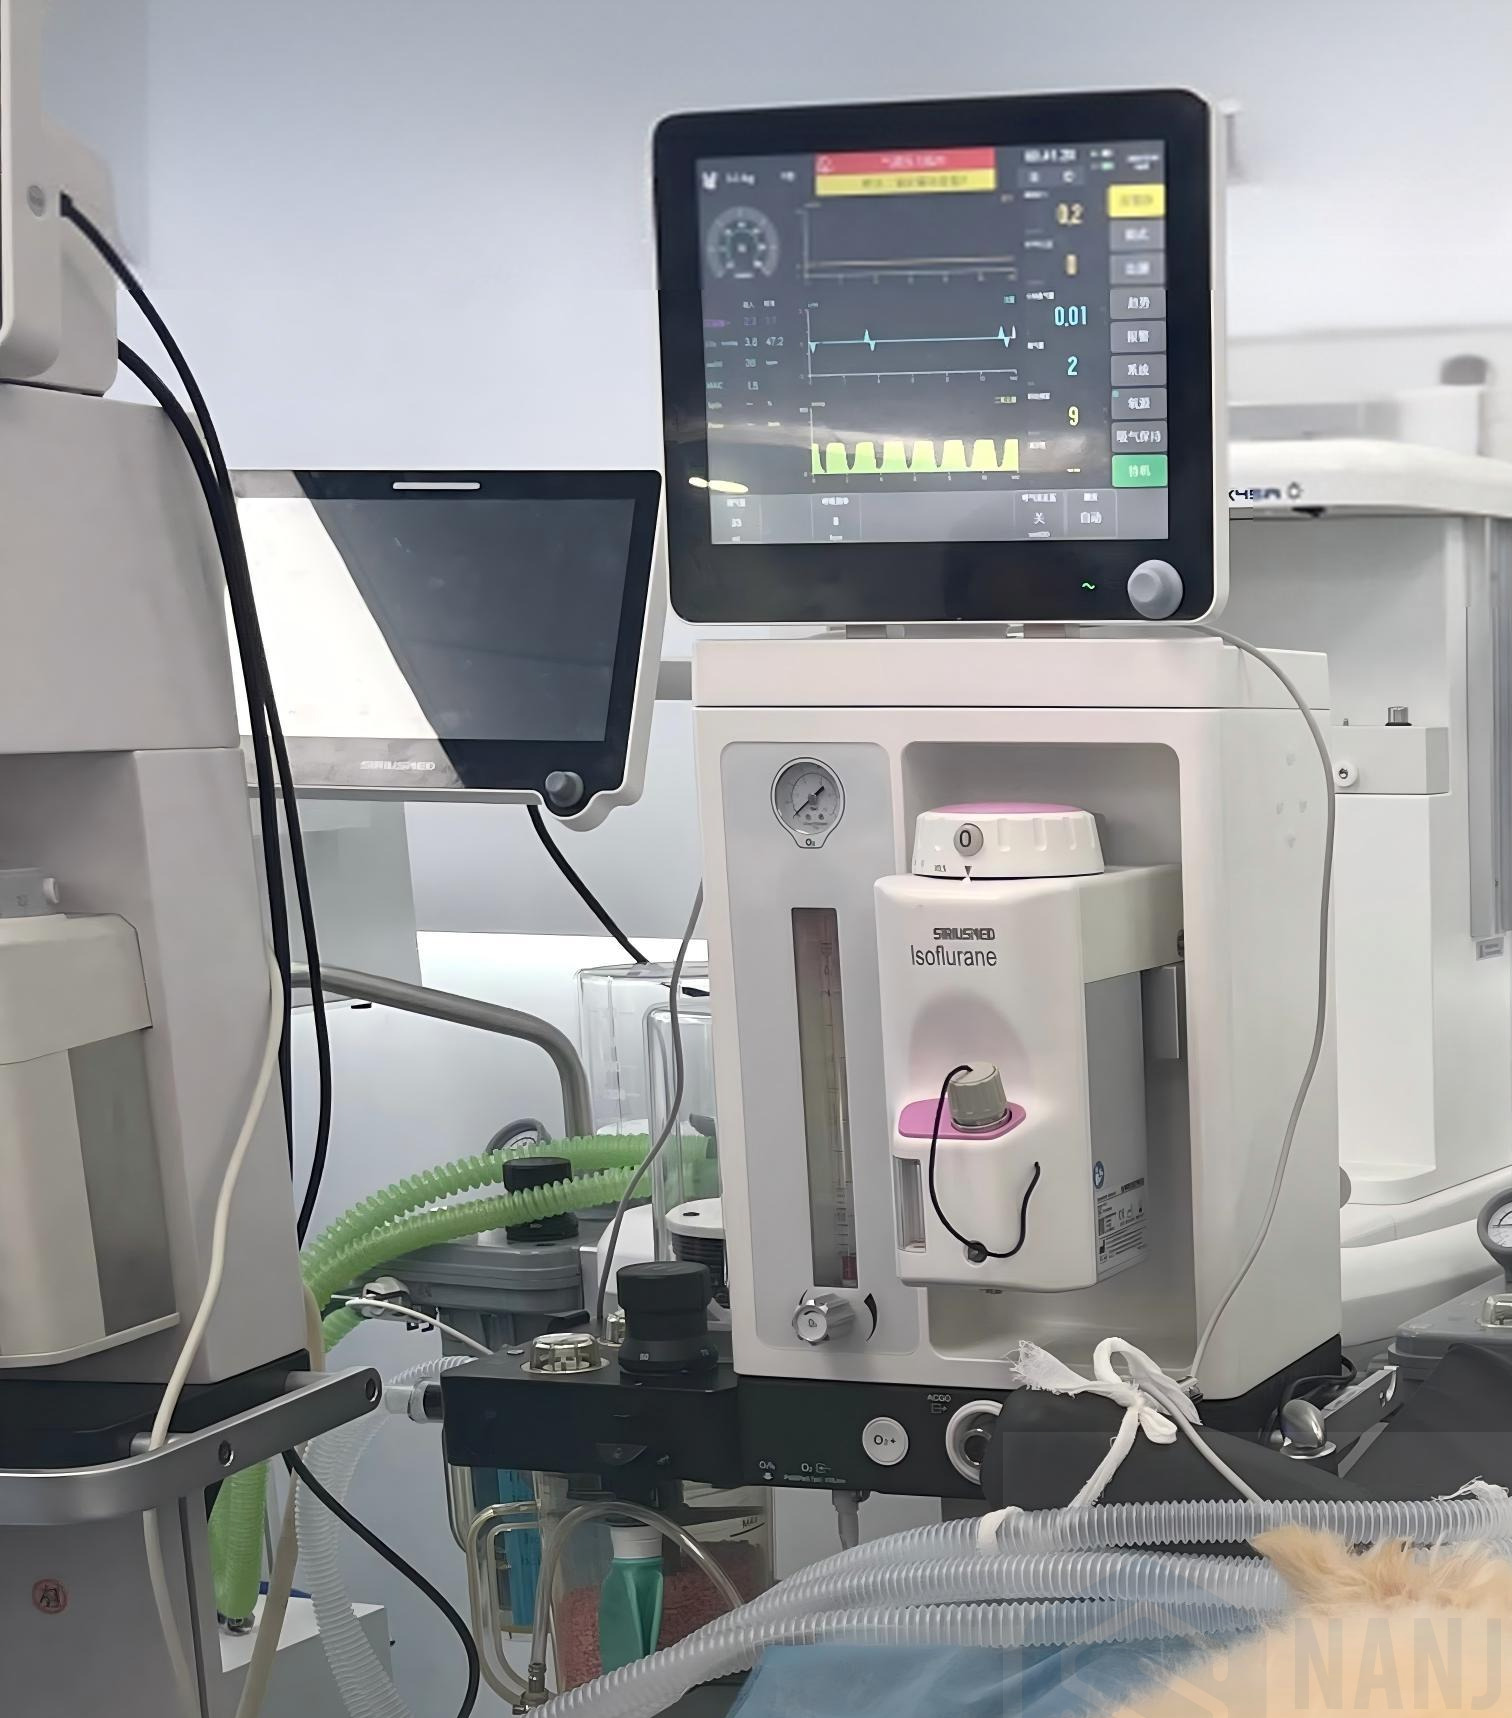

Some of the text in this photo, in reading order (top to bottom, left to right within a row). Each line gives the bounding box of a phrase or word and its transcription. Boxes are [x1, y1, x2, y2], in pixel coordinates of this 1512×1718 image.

[1054, 305, 1087, 327] 0.01
[1067, 356, 1078, 376] 2
[1068, 405, 1079, 426] 9
[910, 944, 997, 967] Isoflurane
